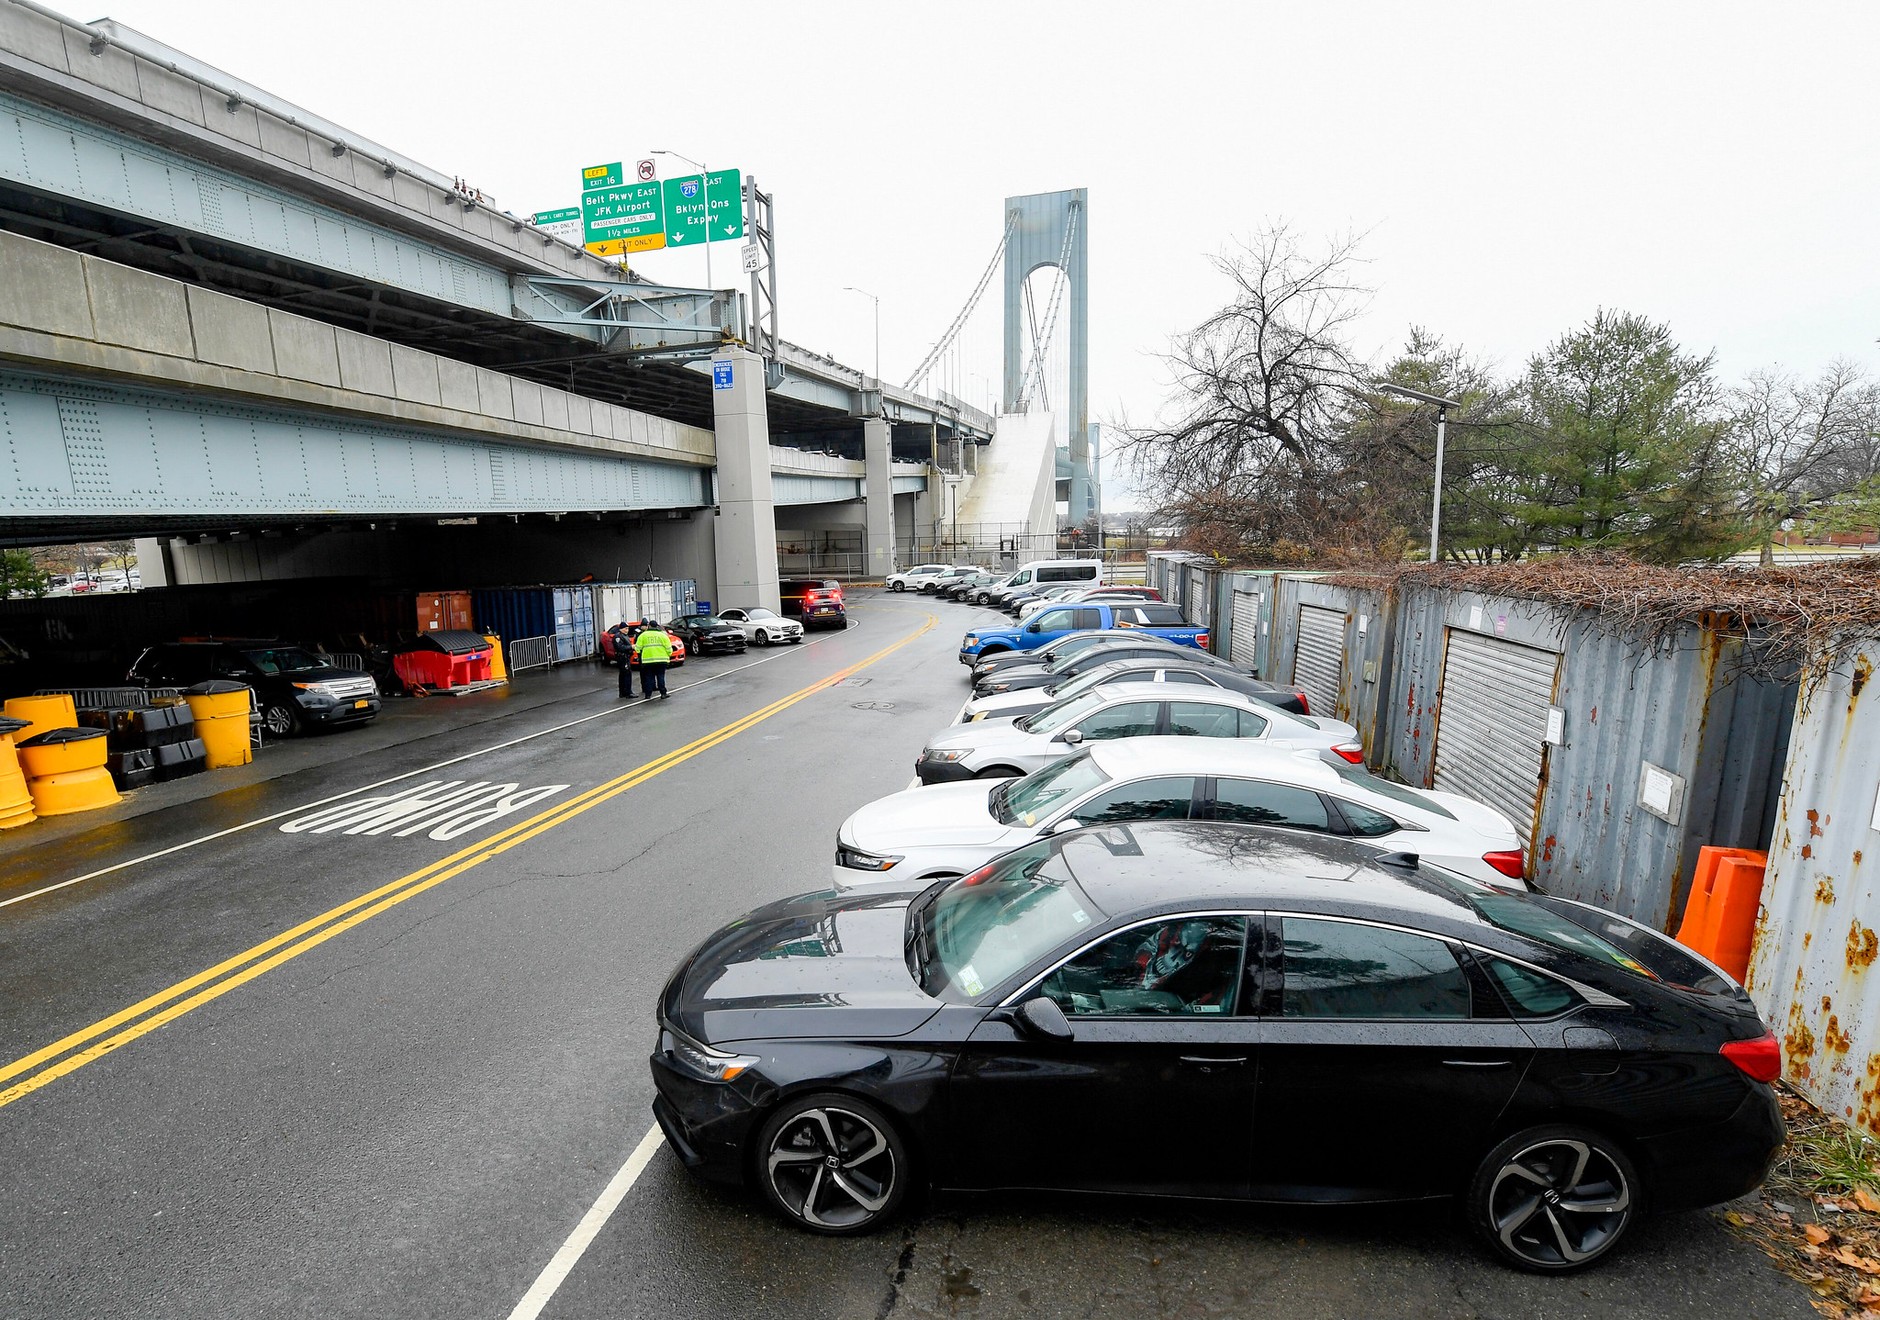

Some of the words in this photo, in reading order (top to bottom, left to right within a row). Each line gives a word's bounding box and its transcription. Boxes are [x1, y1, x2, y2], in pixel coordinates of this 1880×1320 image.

[607, 176, 615, 184] 16
[684, 186, 696, 194] 278
[586, 195, 604, 205] Belt
[609, 192, 633, 202] Pkwy
[638, 188, 656, 197] EAST
[594, 207, 612, 216] JFK
[617, 200, 650, 213] Airport
[594, 219, 621, 227] PASSENGER
[687, 215, 718, 225] Expwy
[746, 260, 757, 269] 45
